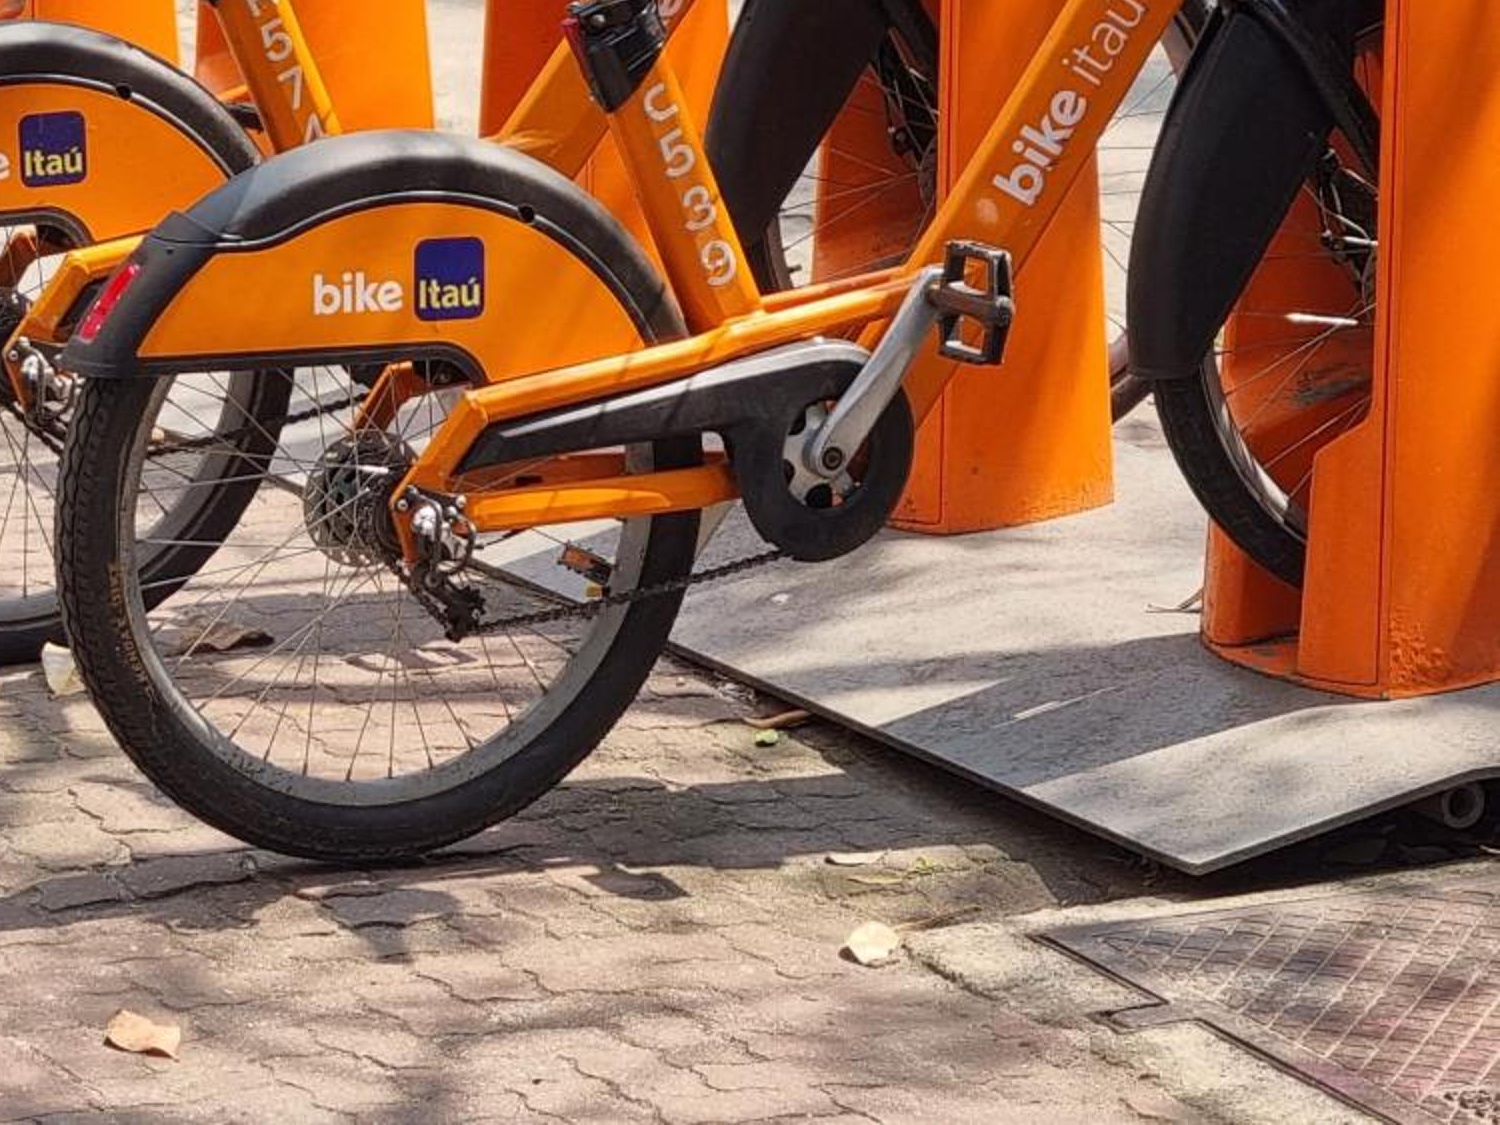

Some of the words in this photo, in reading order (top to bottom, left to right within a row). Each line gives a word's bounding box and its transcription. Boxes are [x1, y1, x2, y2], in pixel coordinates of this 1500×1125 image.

[24, 144, 83, 178] Itaú
[643, 82, 737, 287] C539
[993, 87, 1088, 208] bike
[312, 271, 403, 315] bike
[418, 278, 481, 309] Itaú
